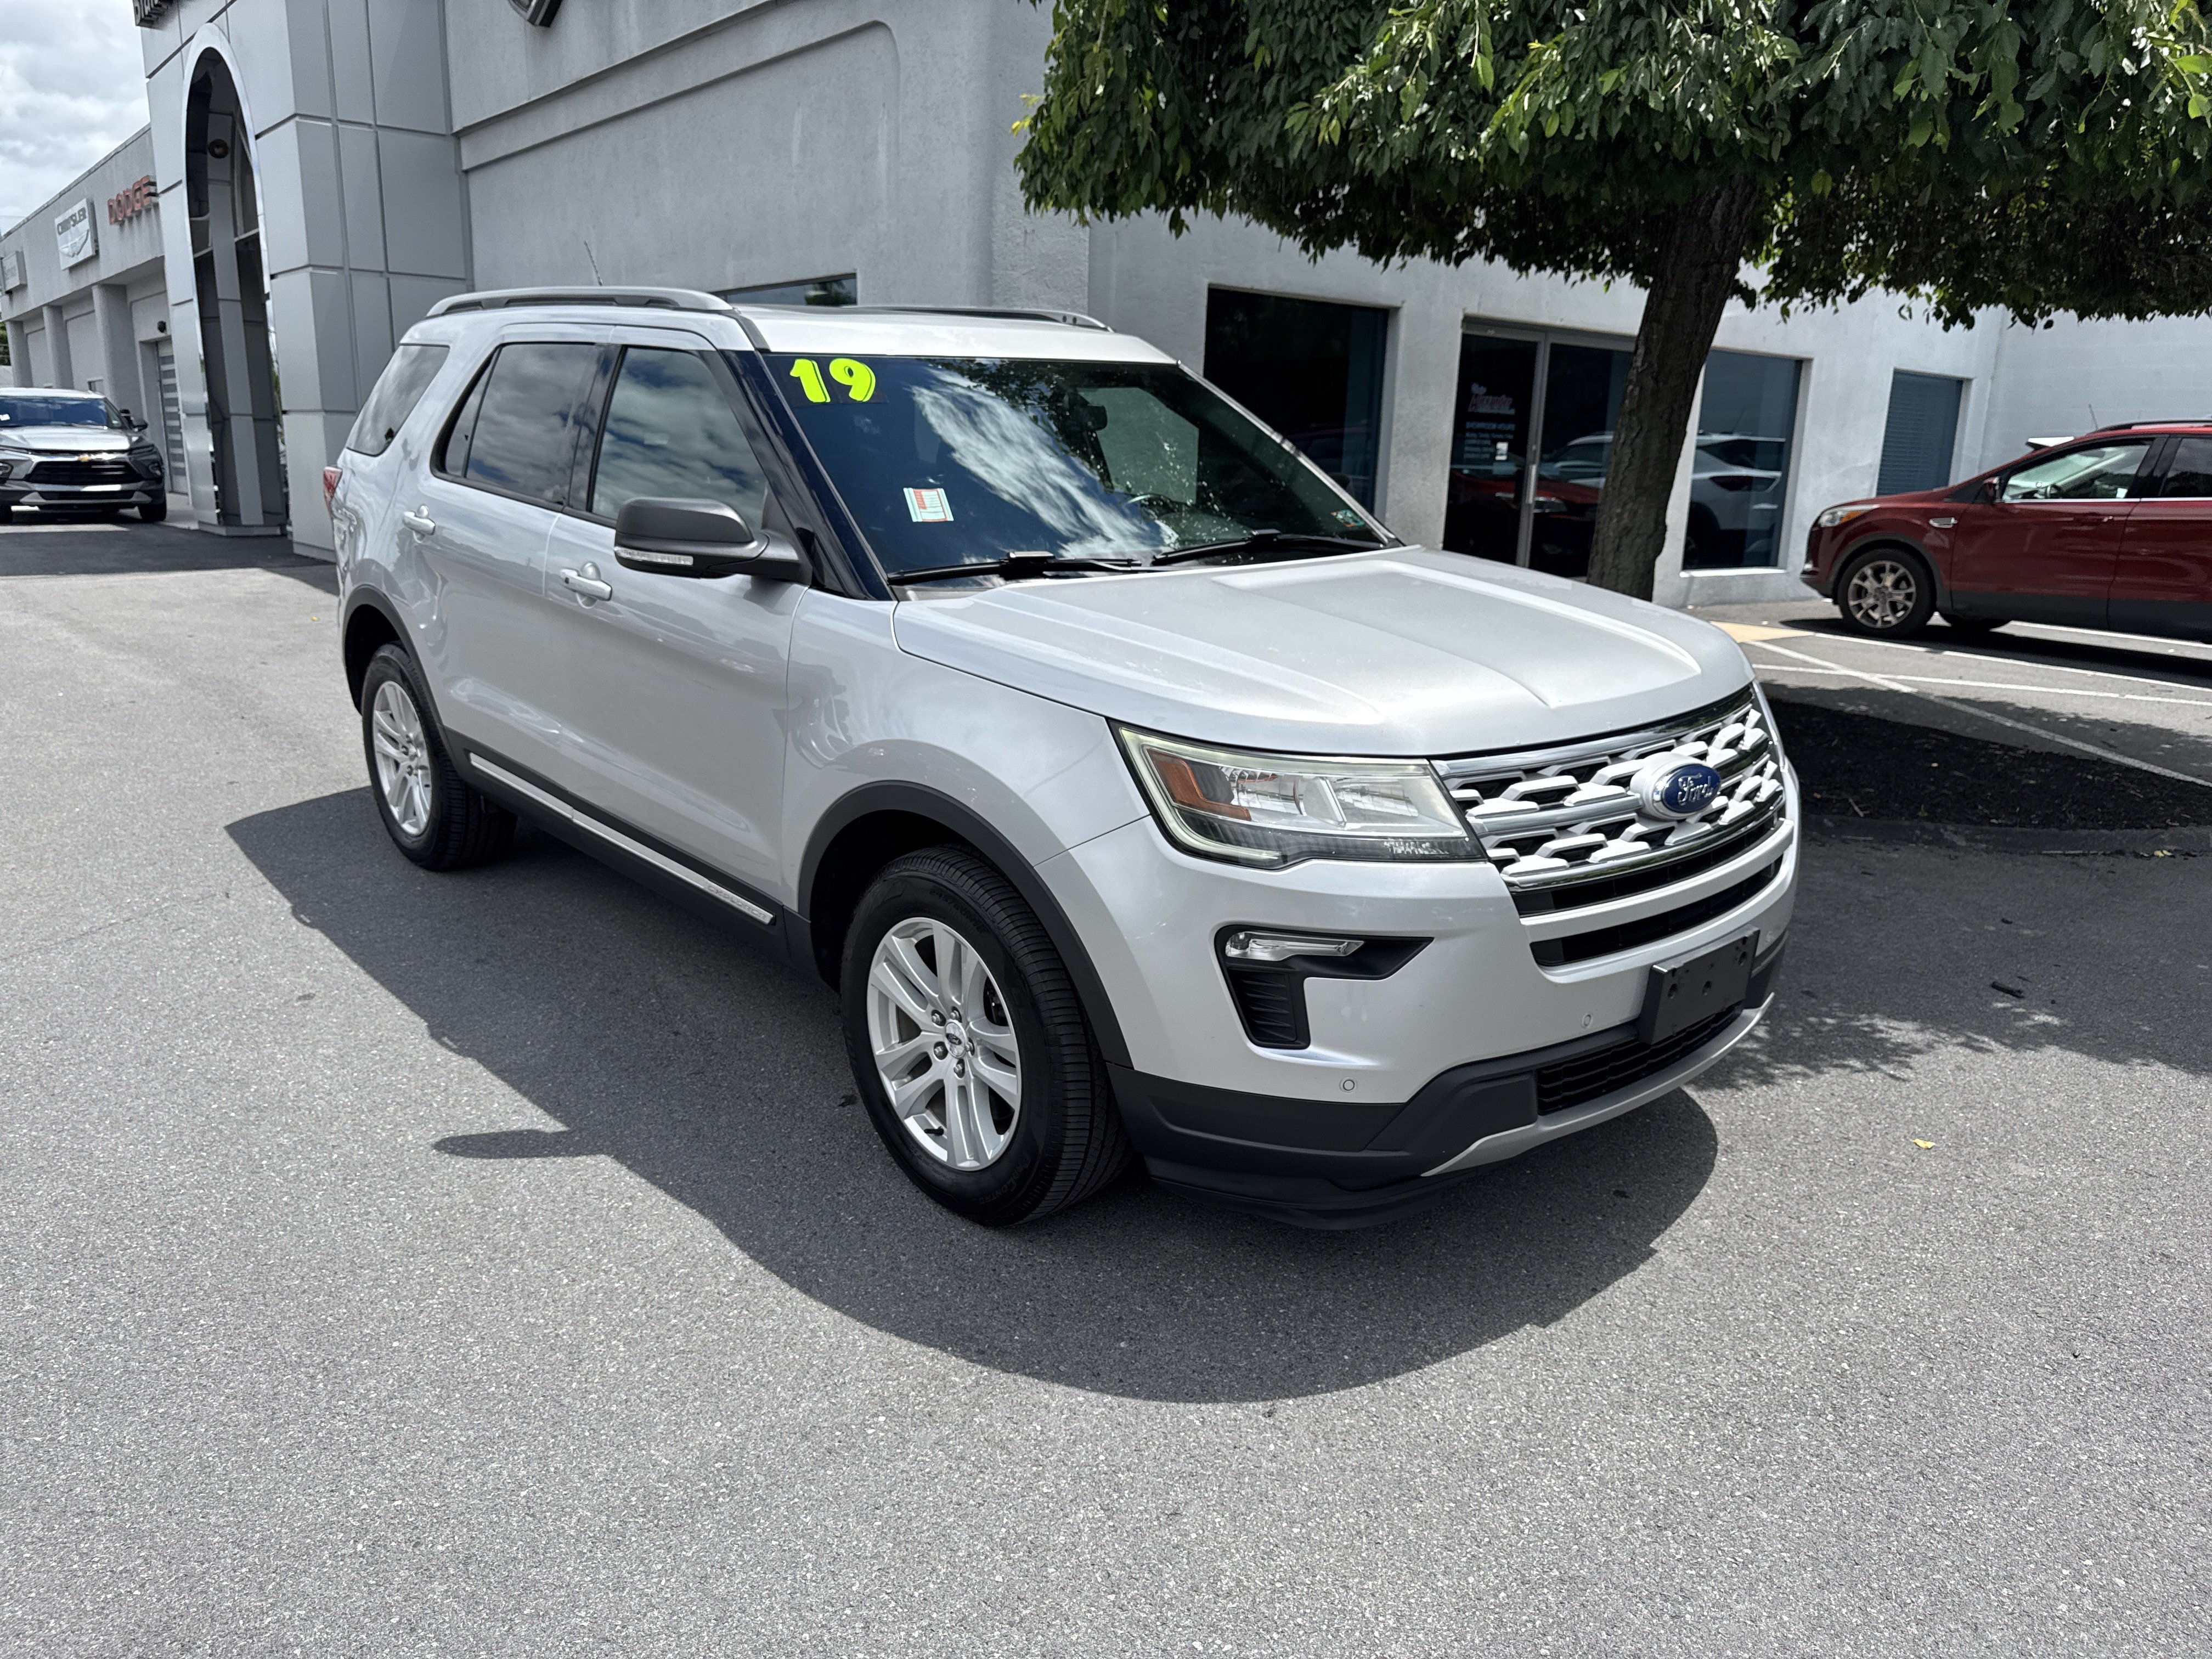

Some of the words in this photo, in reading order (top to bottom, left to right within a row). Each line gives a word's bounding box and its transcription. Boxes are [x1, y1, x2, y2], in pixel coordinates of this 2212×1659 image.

[108, 174, 151, 225] DODGE
[789, 357, 876, 403] 19
[1677, 772, 1714, 806] Ford
